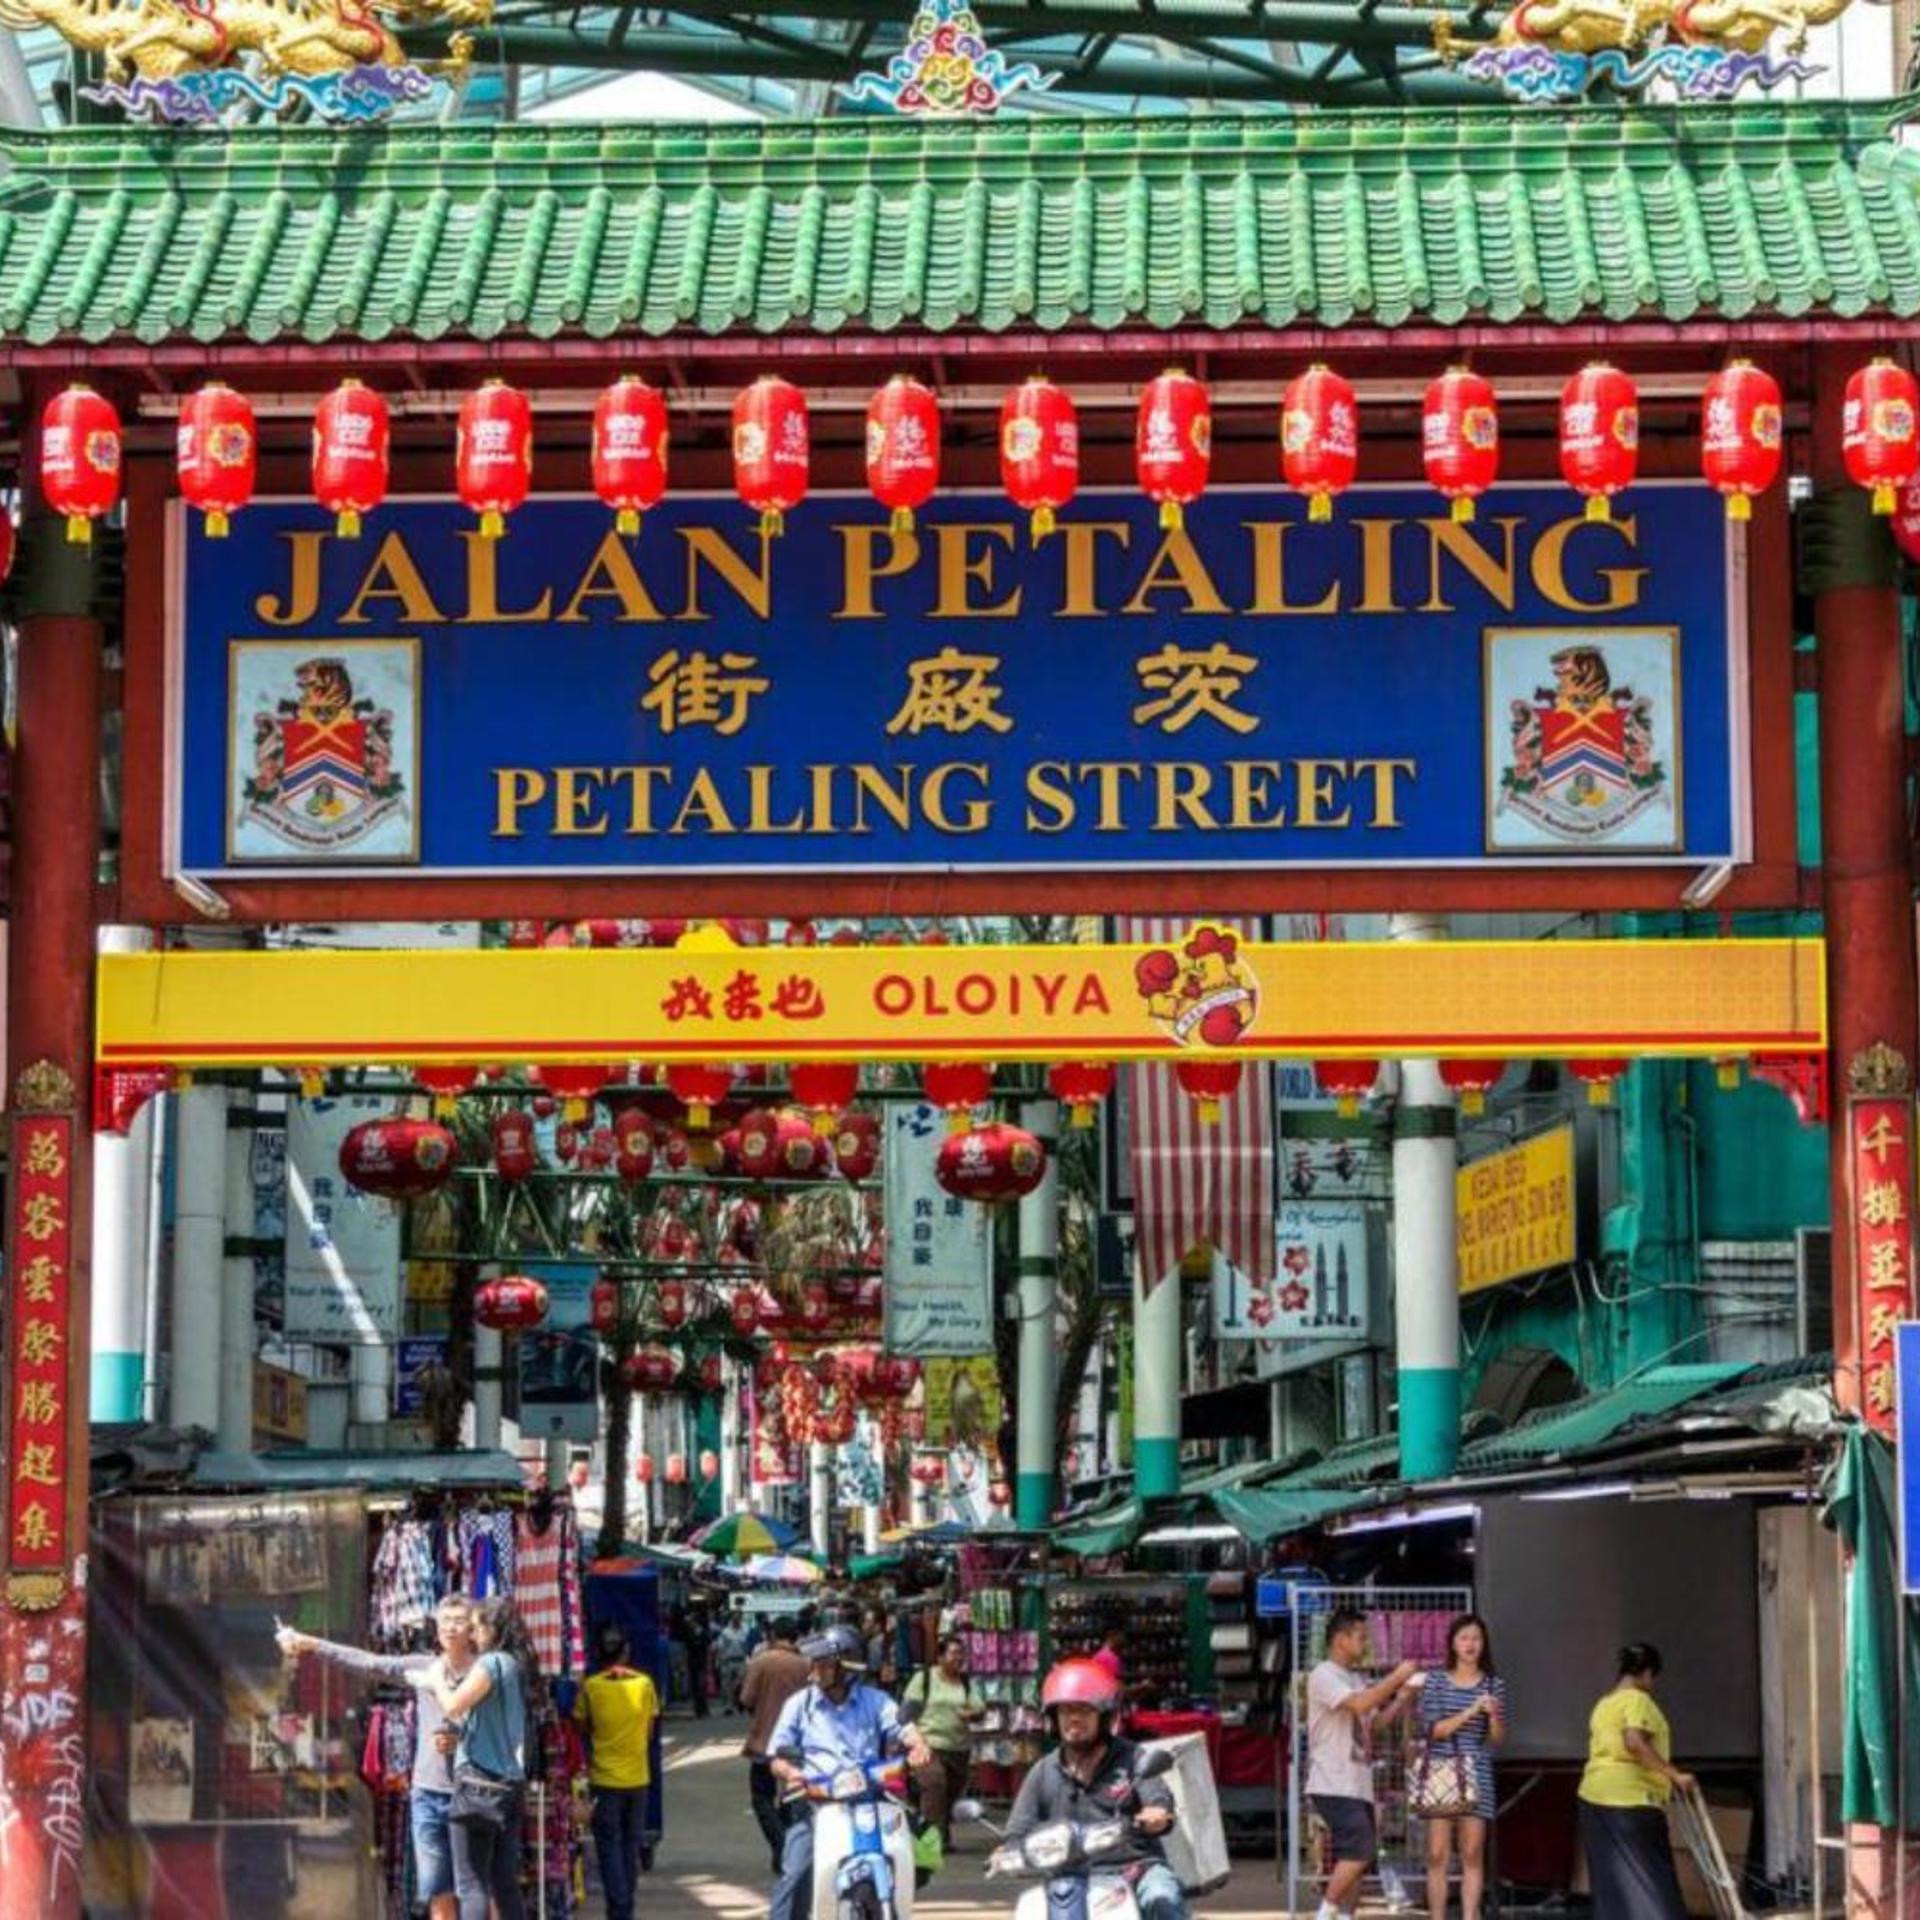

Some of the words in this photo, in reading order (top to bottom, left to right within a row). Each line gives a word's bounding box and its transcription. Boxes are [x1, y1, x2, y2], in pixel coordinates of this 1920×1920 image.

[256, 527, 776, 625] JALAN
[831, 516, 1652, 617] PETALING
[491, 763, 991, 837] PETALING
[1026, 759, 1416, 832] STREET
[873, 974, 1112, 1017] OLOIYA
